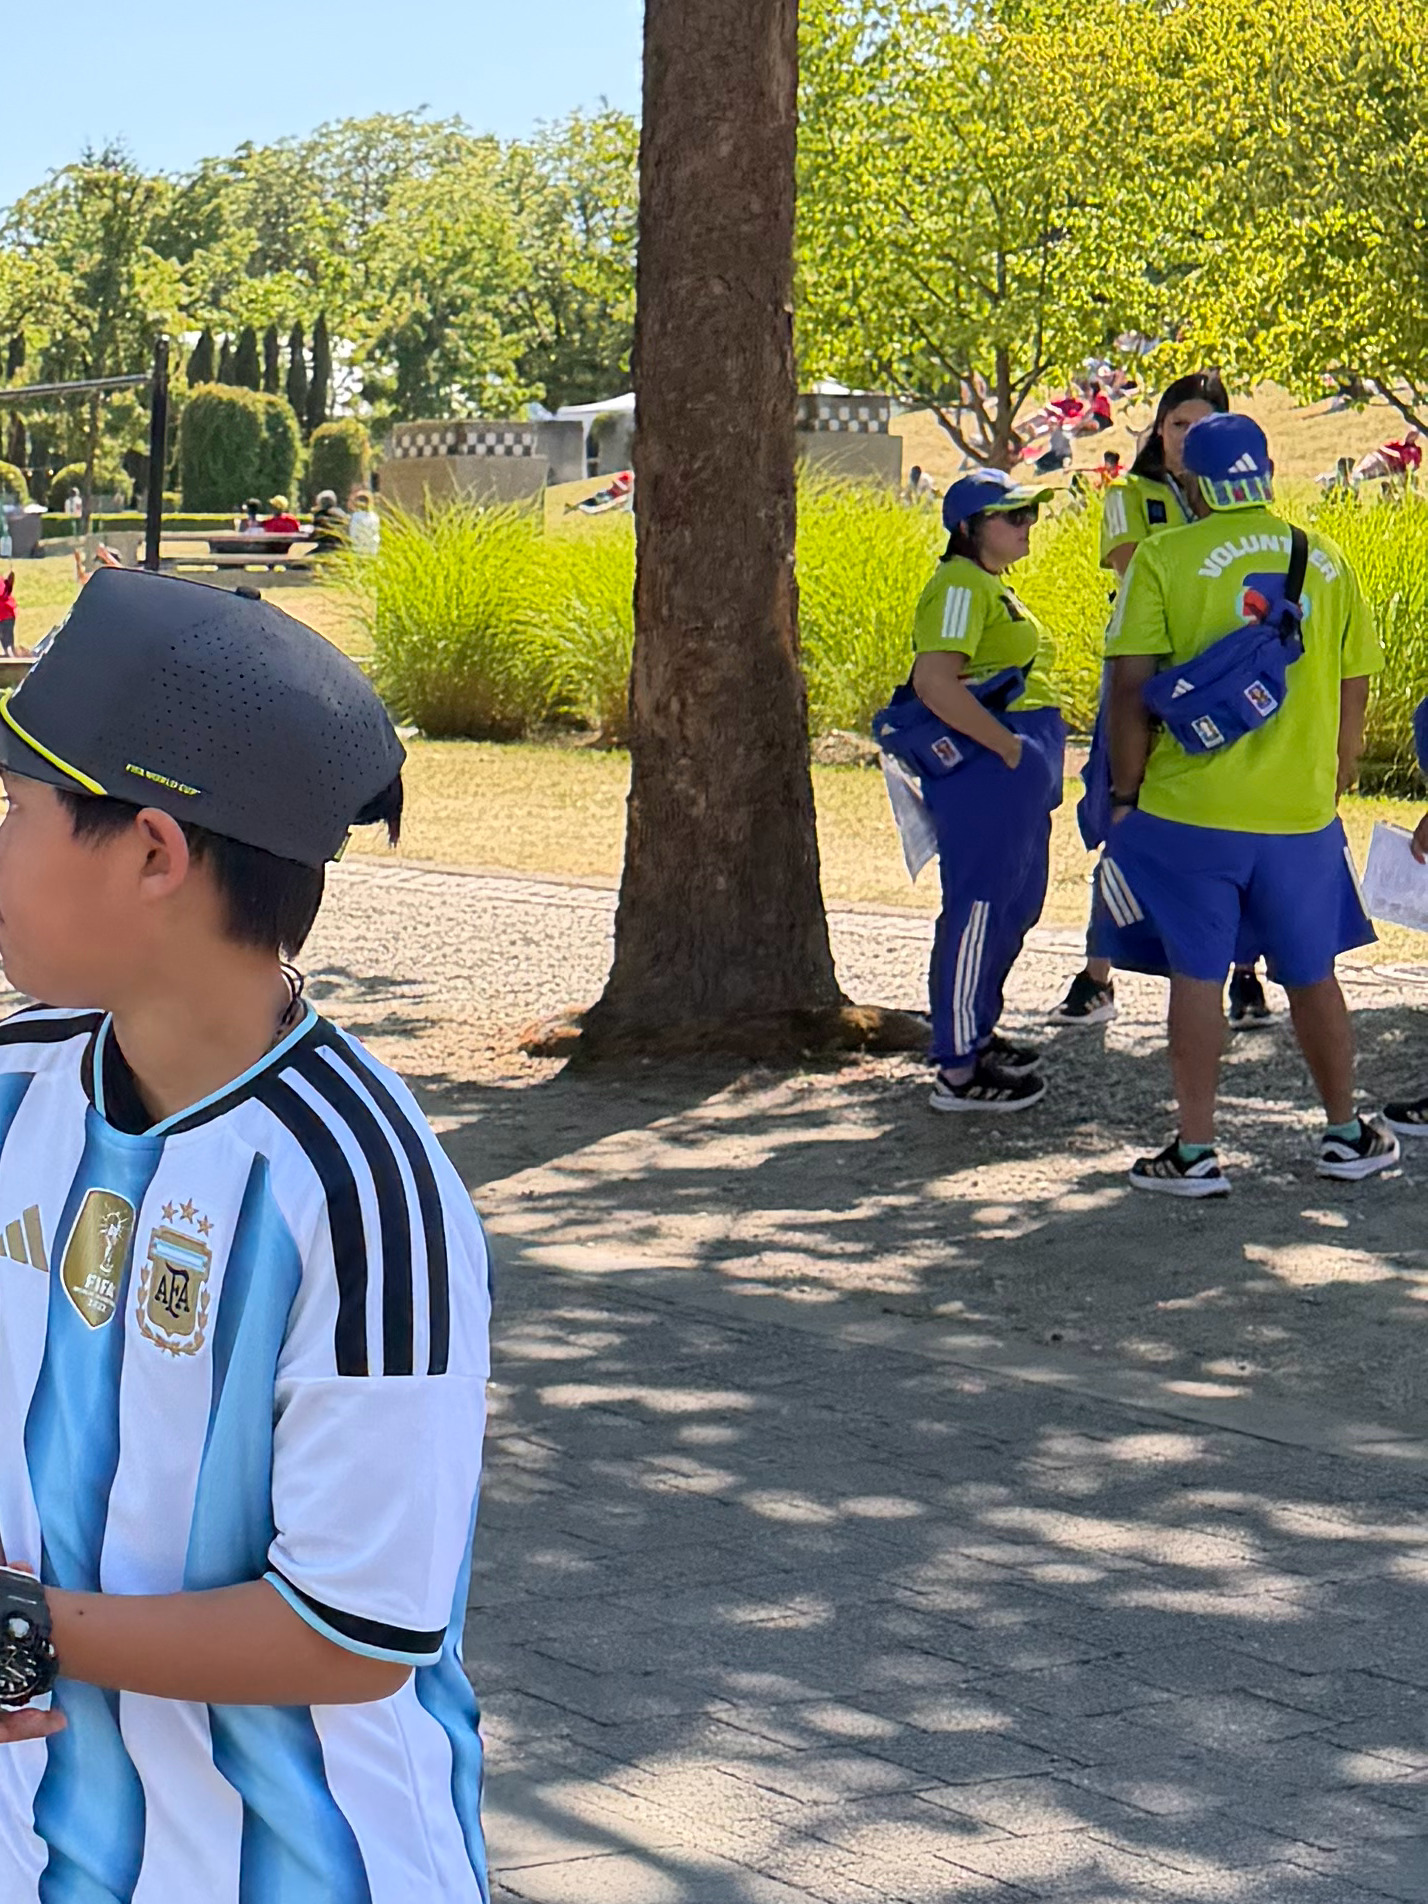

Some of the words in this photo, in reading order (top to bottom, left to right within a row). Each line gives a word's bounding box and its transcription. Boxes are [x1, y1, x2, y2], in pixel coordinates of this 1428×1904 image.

[1198, 533, 1339, 584] VOLUNTER
[84, 1272, 116, 1299] FIFA
[154, 1262, 191, 1318] AFA
